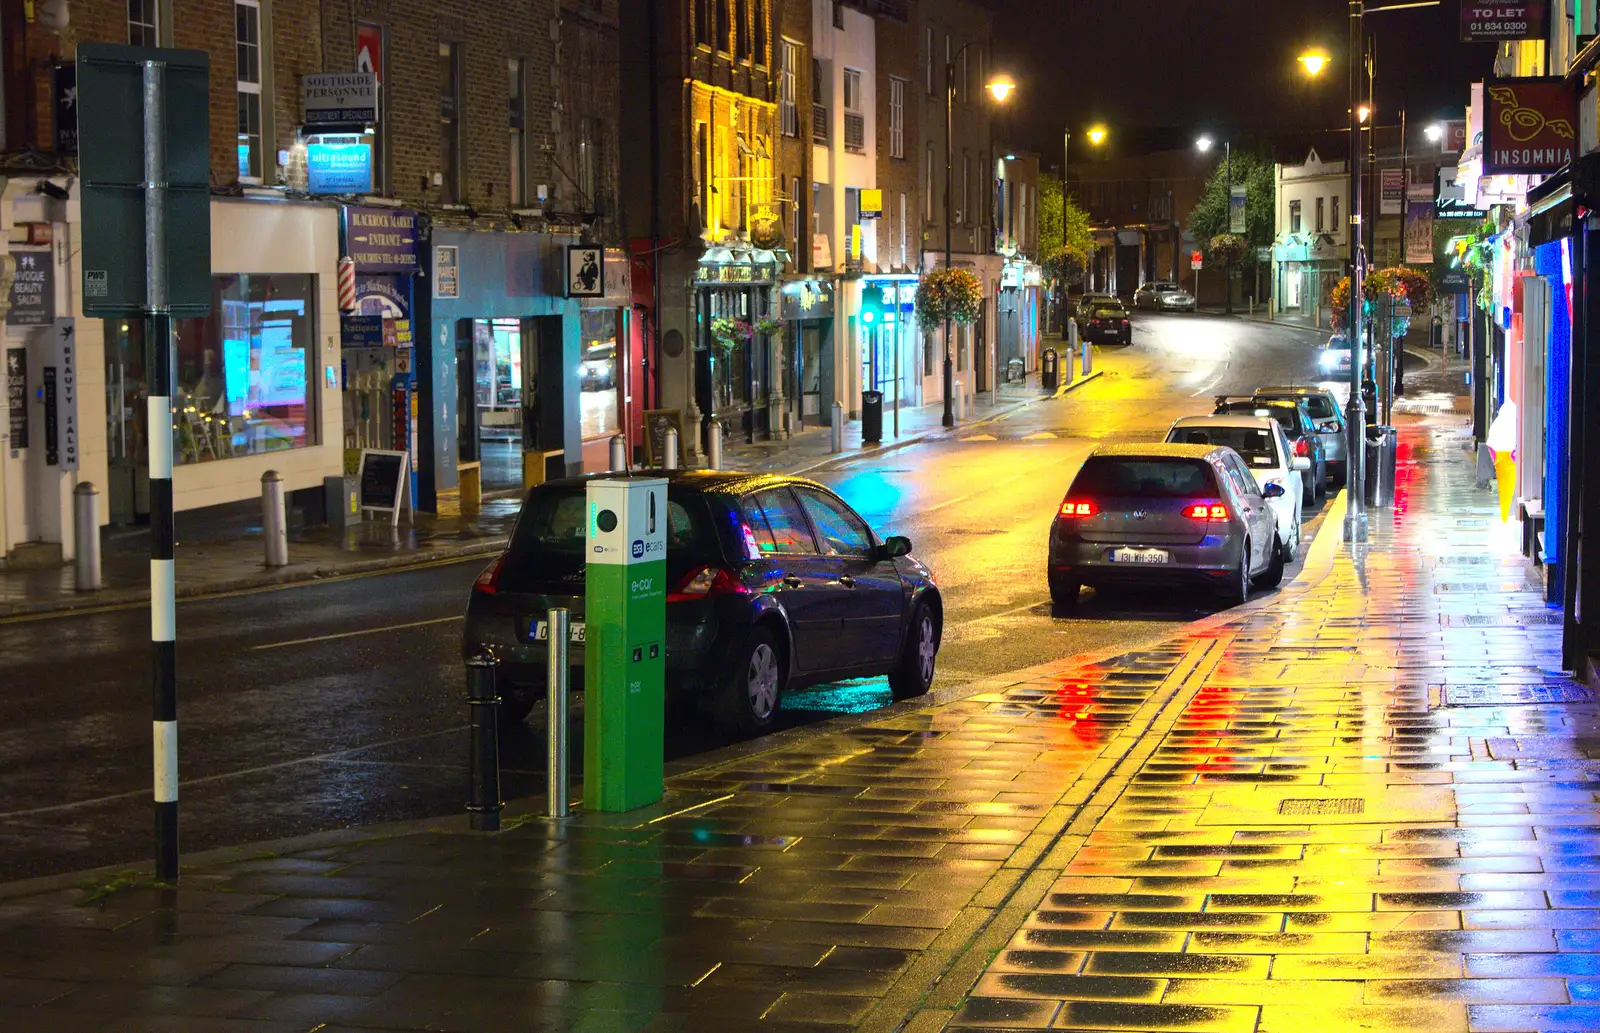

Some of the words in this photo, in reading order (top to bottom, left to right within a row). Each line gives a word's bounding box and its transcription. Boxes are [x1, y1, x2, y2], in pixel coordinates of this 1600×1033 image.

[1473, 9, 1493, 18] TO
[1496, 9, 1525, 18] LET
[1471, 23, 1482, 31] 01
[1484, 22, 1502, 30] 634
[1504, 22, 1527, 30] 0300
[307, 76, 372, 87] SOUTHSIDE
[306, 87, 373, 98] PERSONNEL
[307, 110, 340, 121] RECRUITMENT
[312, 151, 367, 163] ultrasound
[1494, 148, 1572, 165] INSOMNIA
[352, 213, 389, 227] BLACKROCK
[391, 215, 414, 228] MARKET
[369, 233, 401, 246] ENTRANCE
[87, 271, 105, 279] PWS
[14, 282, 43, 293] BEAUTY
[16, 294, 42, 305] SALON
[63, 347, 73, 405] BEAUTY
[66, 416, 76, 464] SALON
[645, 540, 664, 553] ecars
